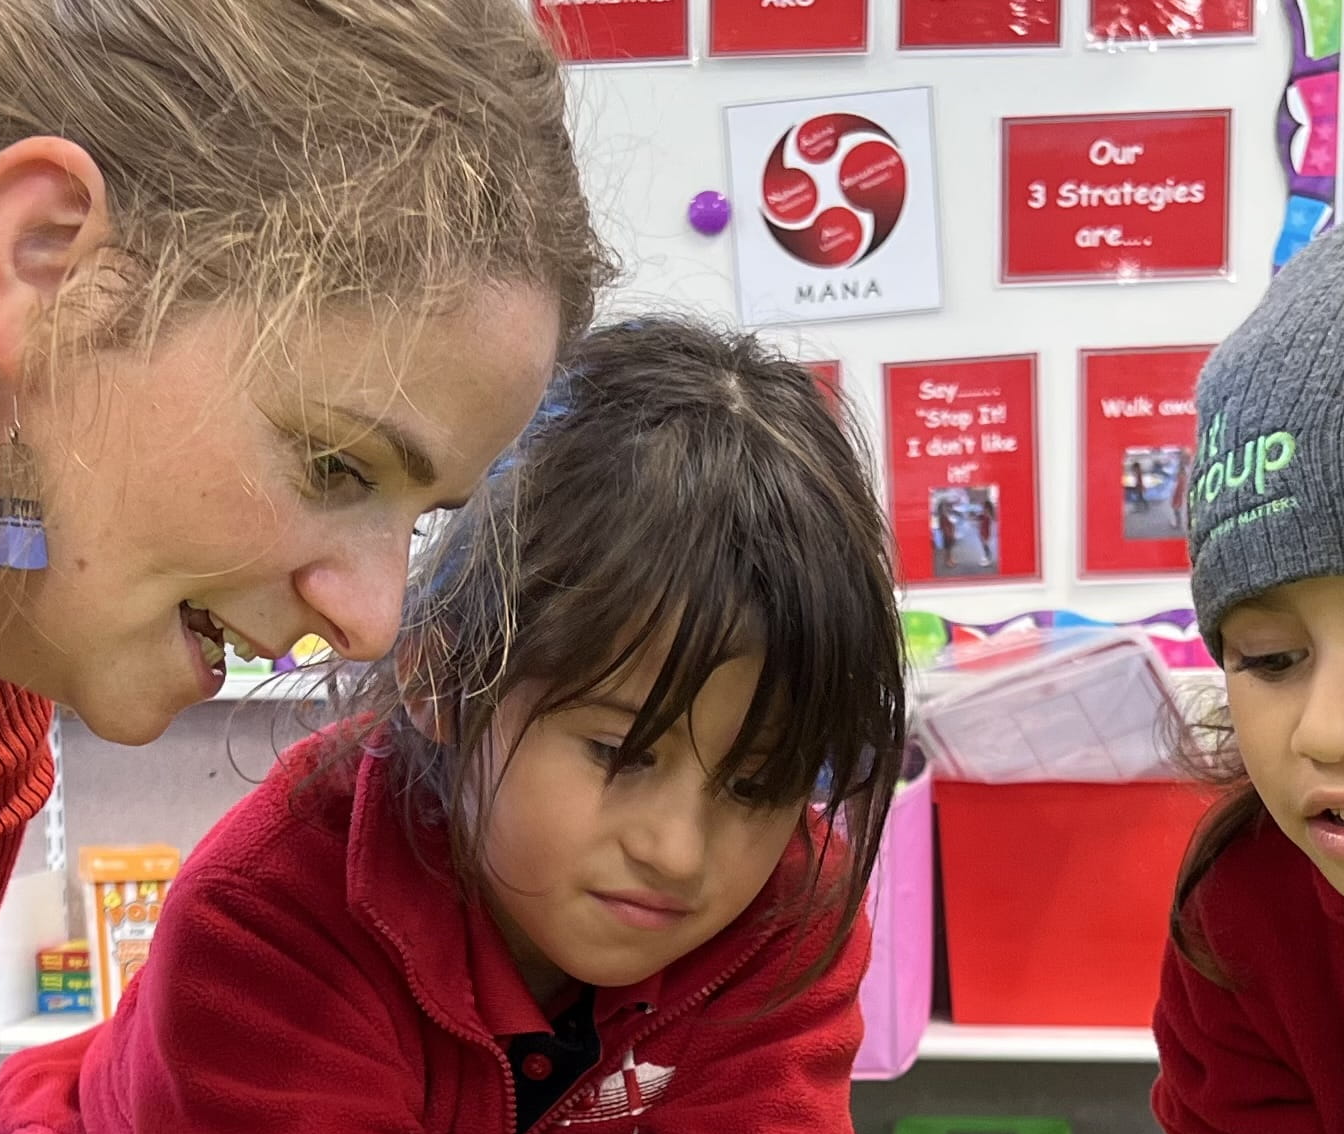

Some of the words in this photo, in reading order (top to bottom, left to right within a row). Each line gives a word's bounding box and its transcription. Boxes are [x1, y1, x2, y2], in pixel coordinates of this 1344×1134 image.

[1089, 139, 1143, 166] Our
[1027, 181, 1047, 209] 3
[1056, 178, 1206, 212] Strategies
[795, 278, 882, 304] MANA
[1100, 397, 1153, 418] Walk
[1158, 400, 1198, 416] awa
[906, 438, 921, 458] I
[981, 431, 1018, 453] like
